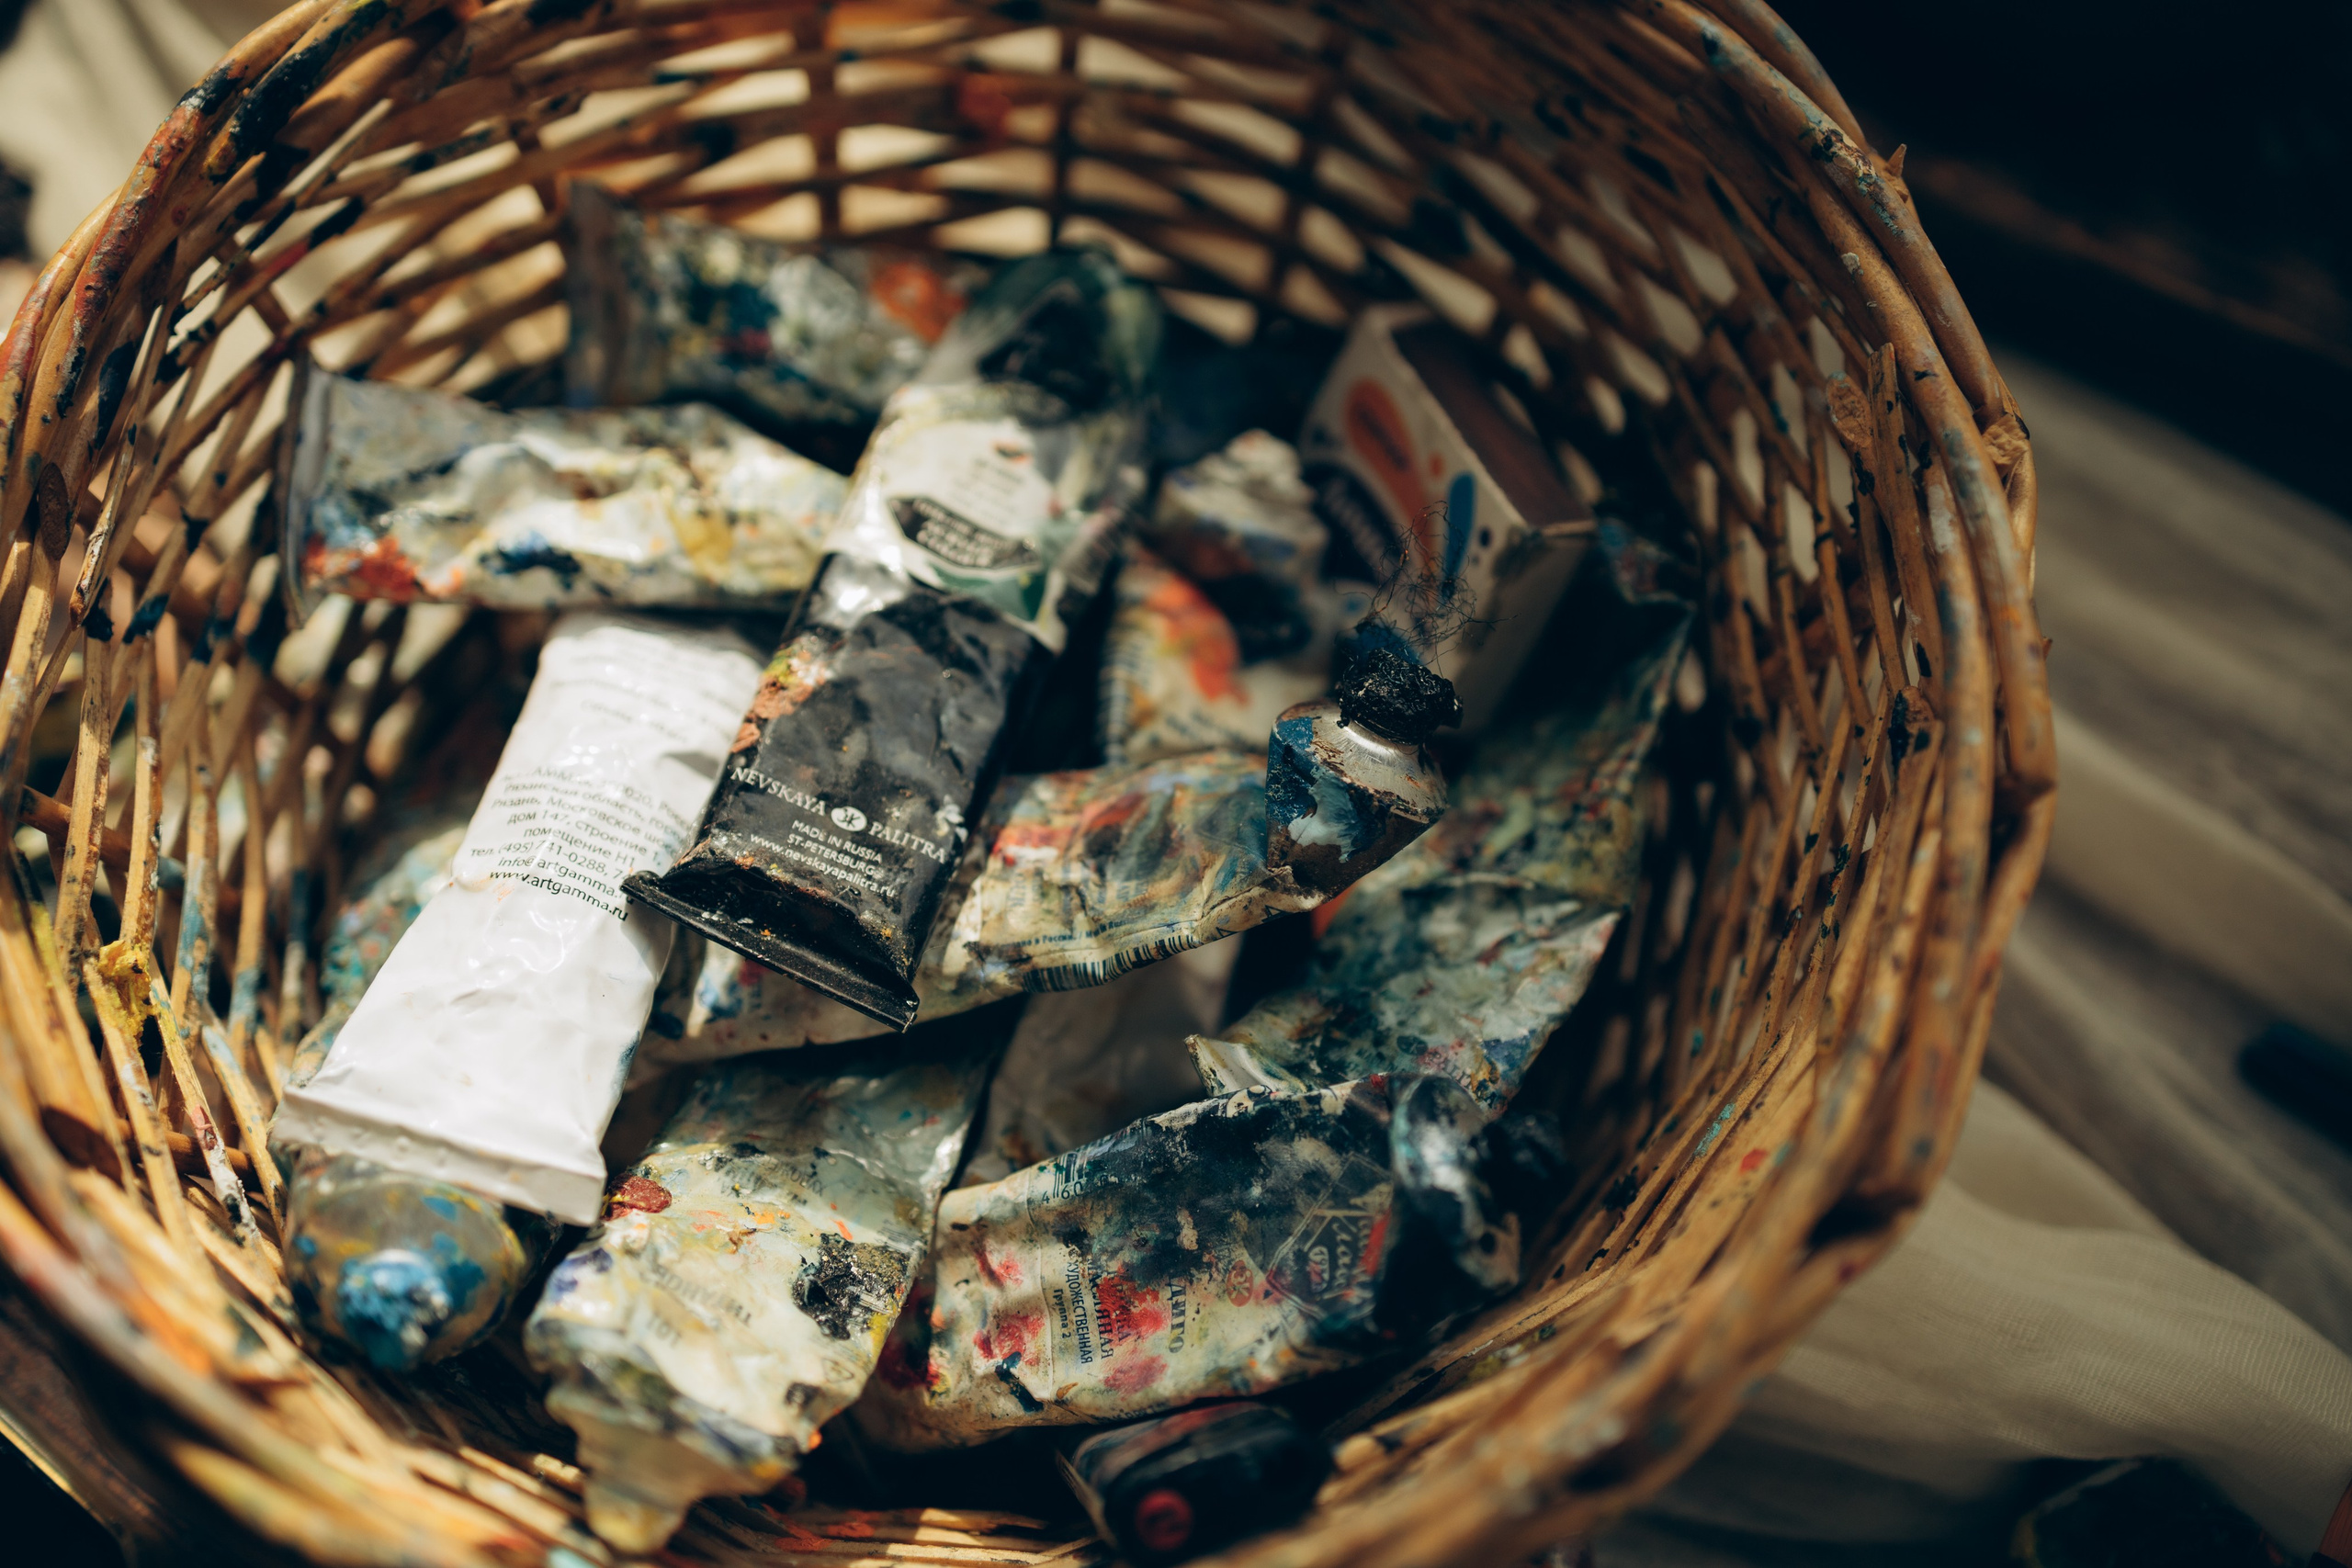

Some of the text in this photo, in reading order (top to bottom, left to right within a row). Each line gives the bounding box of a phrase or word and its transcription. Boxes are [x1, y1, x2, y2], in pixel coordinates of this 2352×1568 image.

[507, 812, 537, 825] дом
[575, 820, 648, 856] строение
[547, 795, 641, 835] Московское
[730, 767, 826, 816] NEVSKAYA
[868, 821, 946, 863] PALITRA
[524, 827, 612, 859] помещение
[786, 833, 876, 878] ST-PETERSBURG
[792, 819, 883, 864] MADE IN RUSSIA
[750, 833, 896, 898] www.nevskayapalitra.ru
[490, 871, 628, 921] www.artgamma.ru
[1054, 1288, 1069, 1329] Группа
[1066, 1259, 1093, 1364] ХУДОЖЕСТВЕННАЯ
